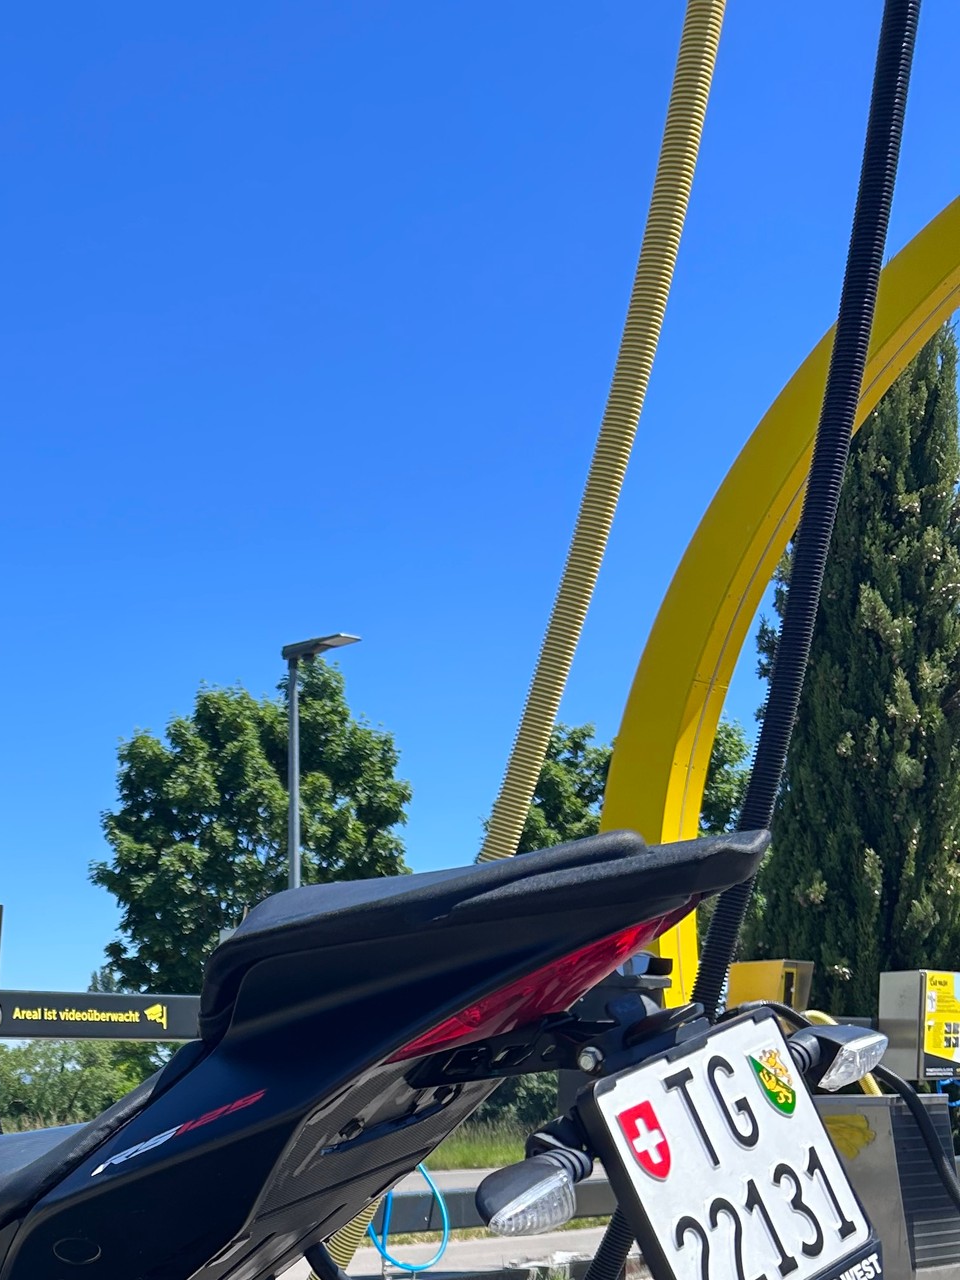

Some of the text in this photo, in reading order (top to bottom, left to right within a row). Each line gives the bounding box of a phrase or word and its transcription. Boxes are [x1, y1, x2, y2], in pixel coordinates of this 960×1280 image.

[13, 1007, 140, 1022] Areal ist videoüberwacht
[664, 1055, 760, 1168] TG
